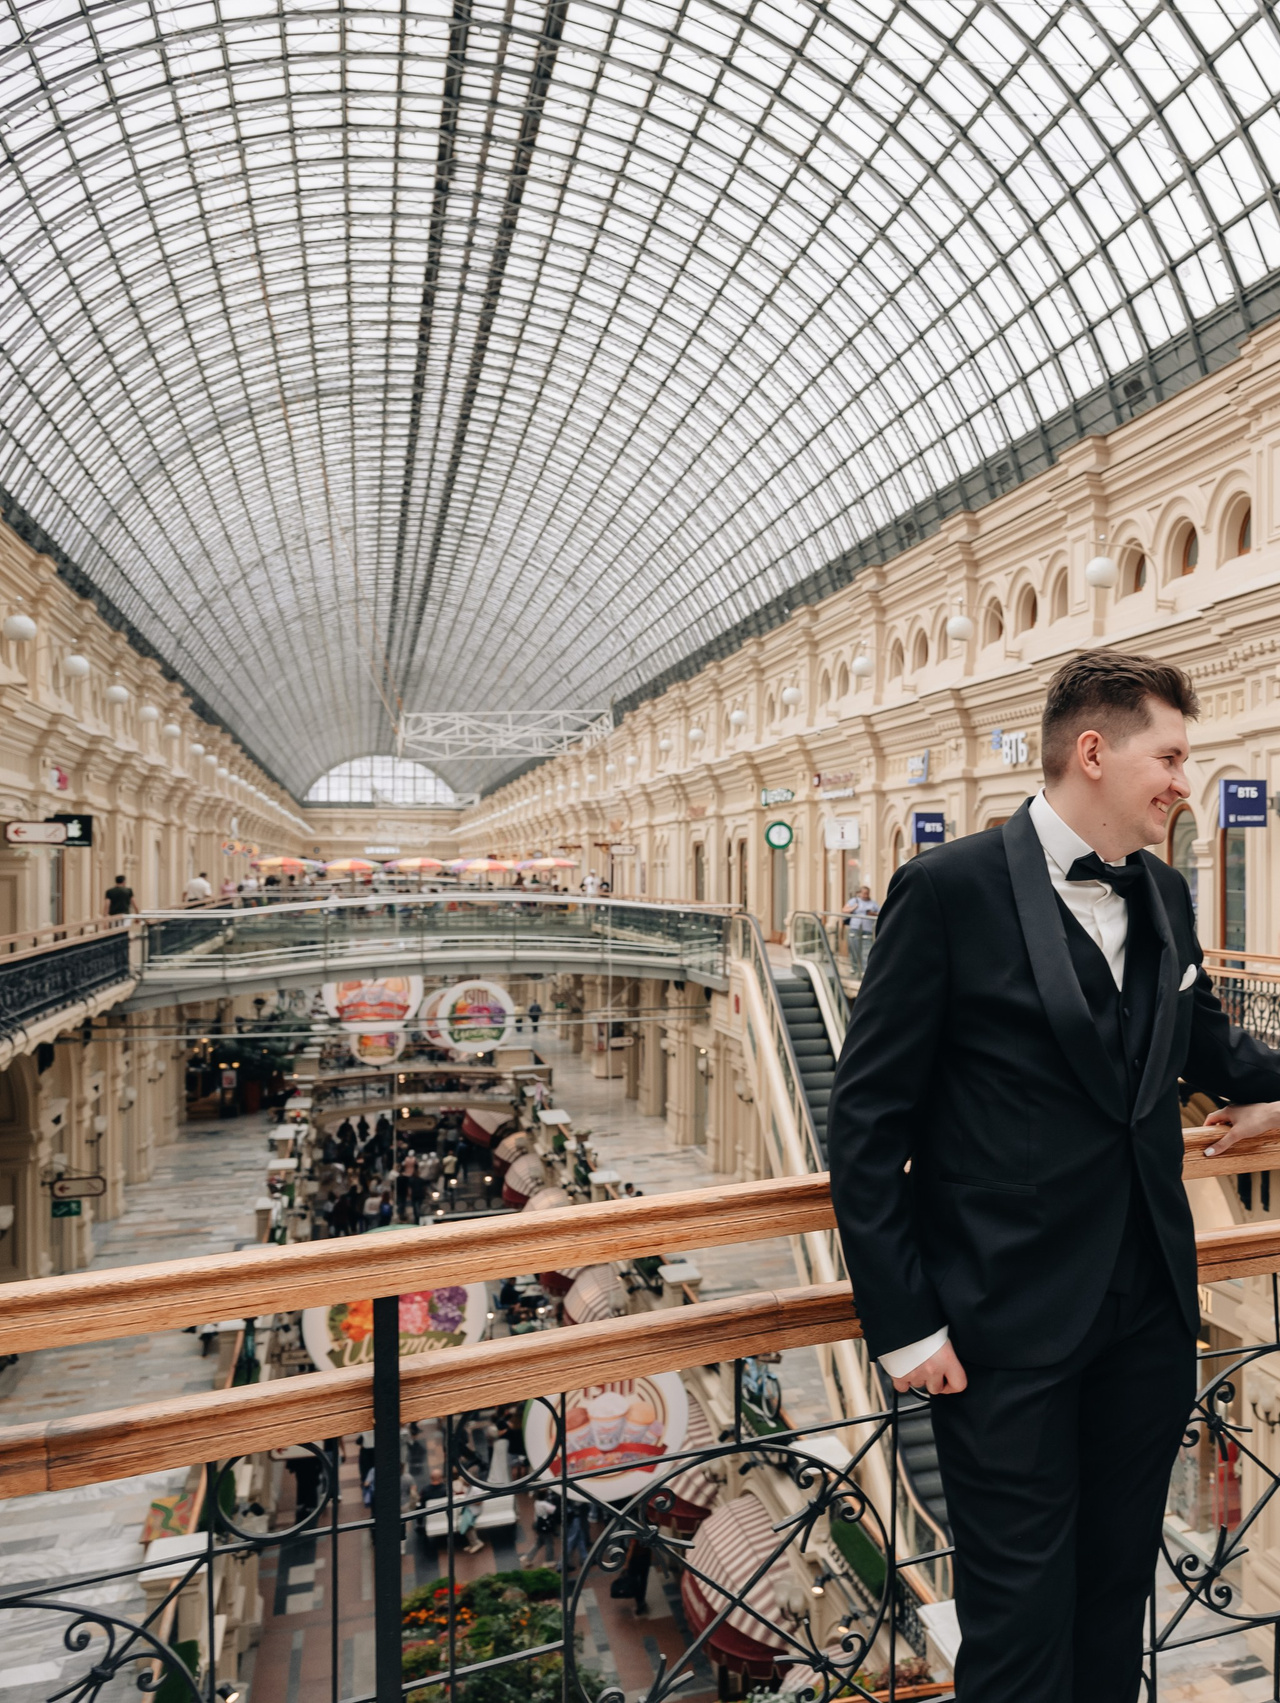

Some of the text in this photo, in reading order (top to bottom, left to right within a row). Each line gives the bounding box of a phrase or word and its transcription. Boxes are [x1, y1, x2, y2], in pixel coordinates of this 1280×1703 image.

[1002, 731, 1028, 765] ВТБ
[1237, 786, 1259, 799] ВТБ
[924, 822, 943, 833] ВТБ
